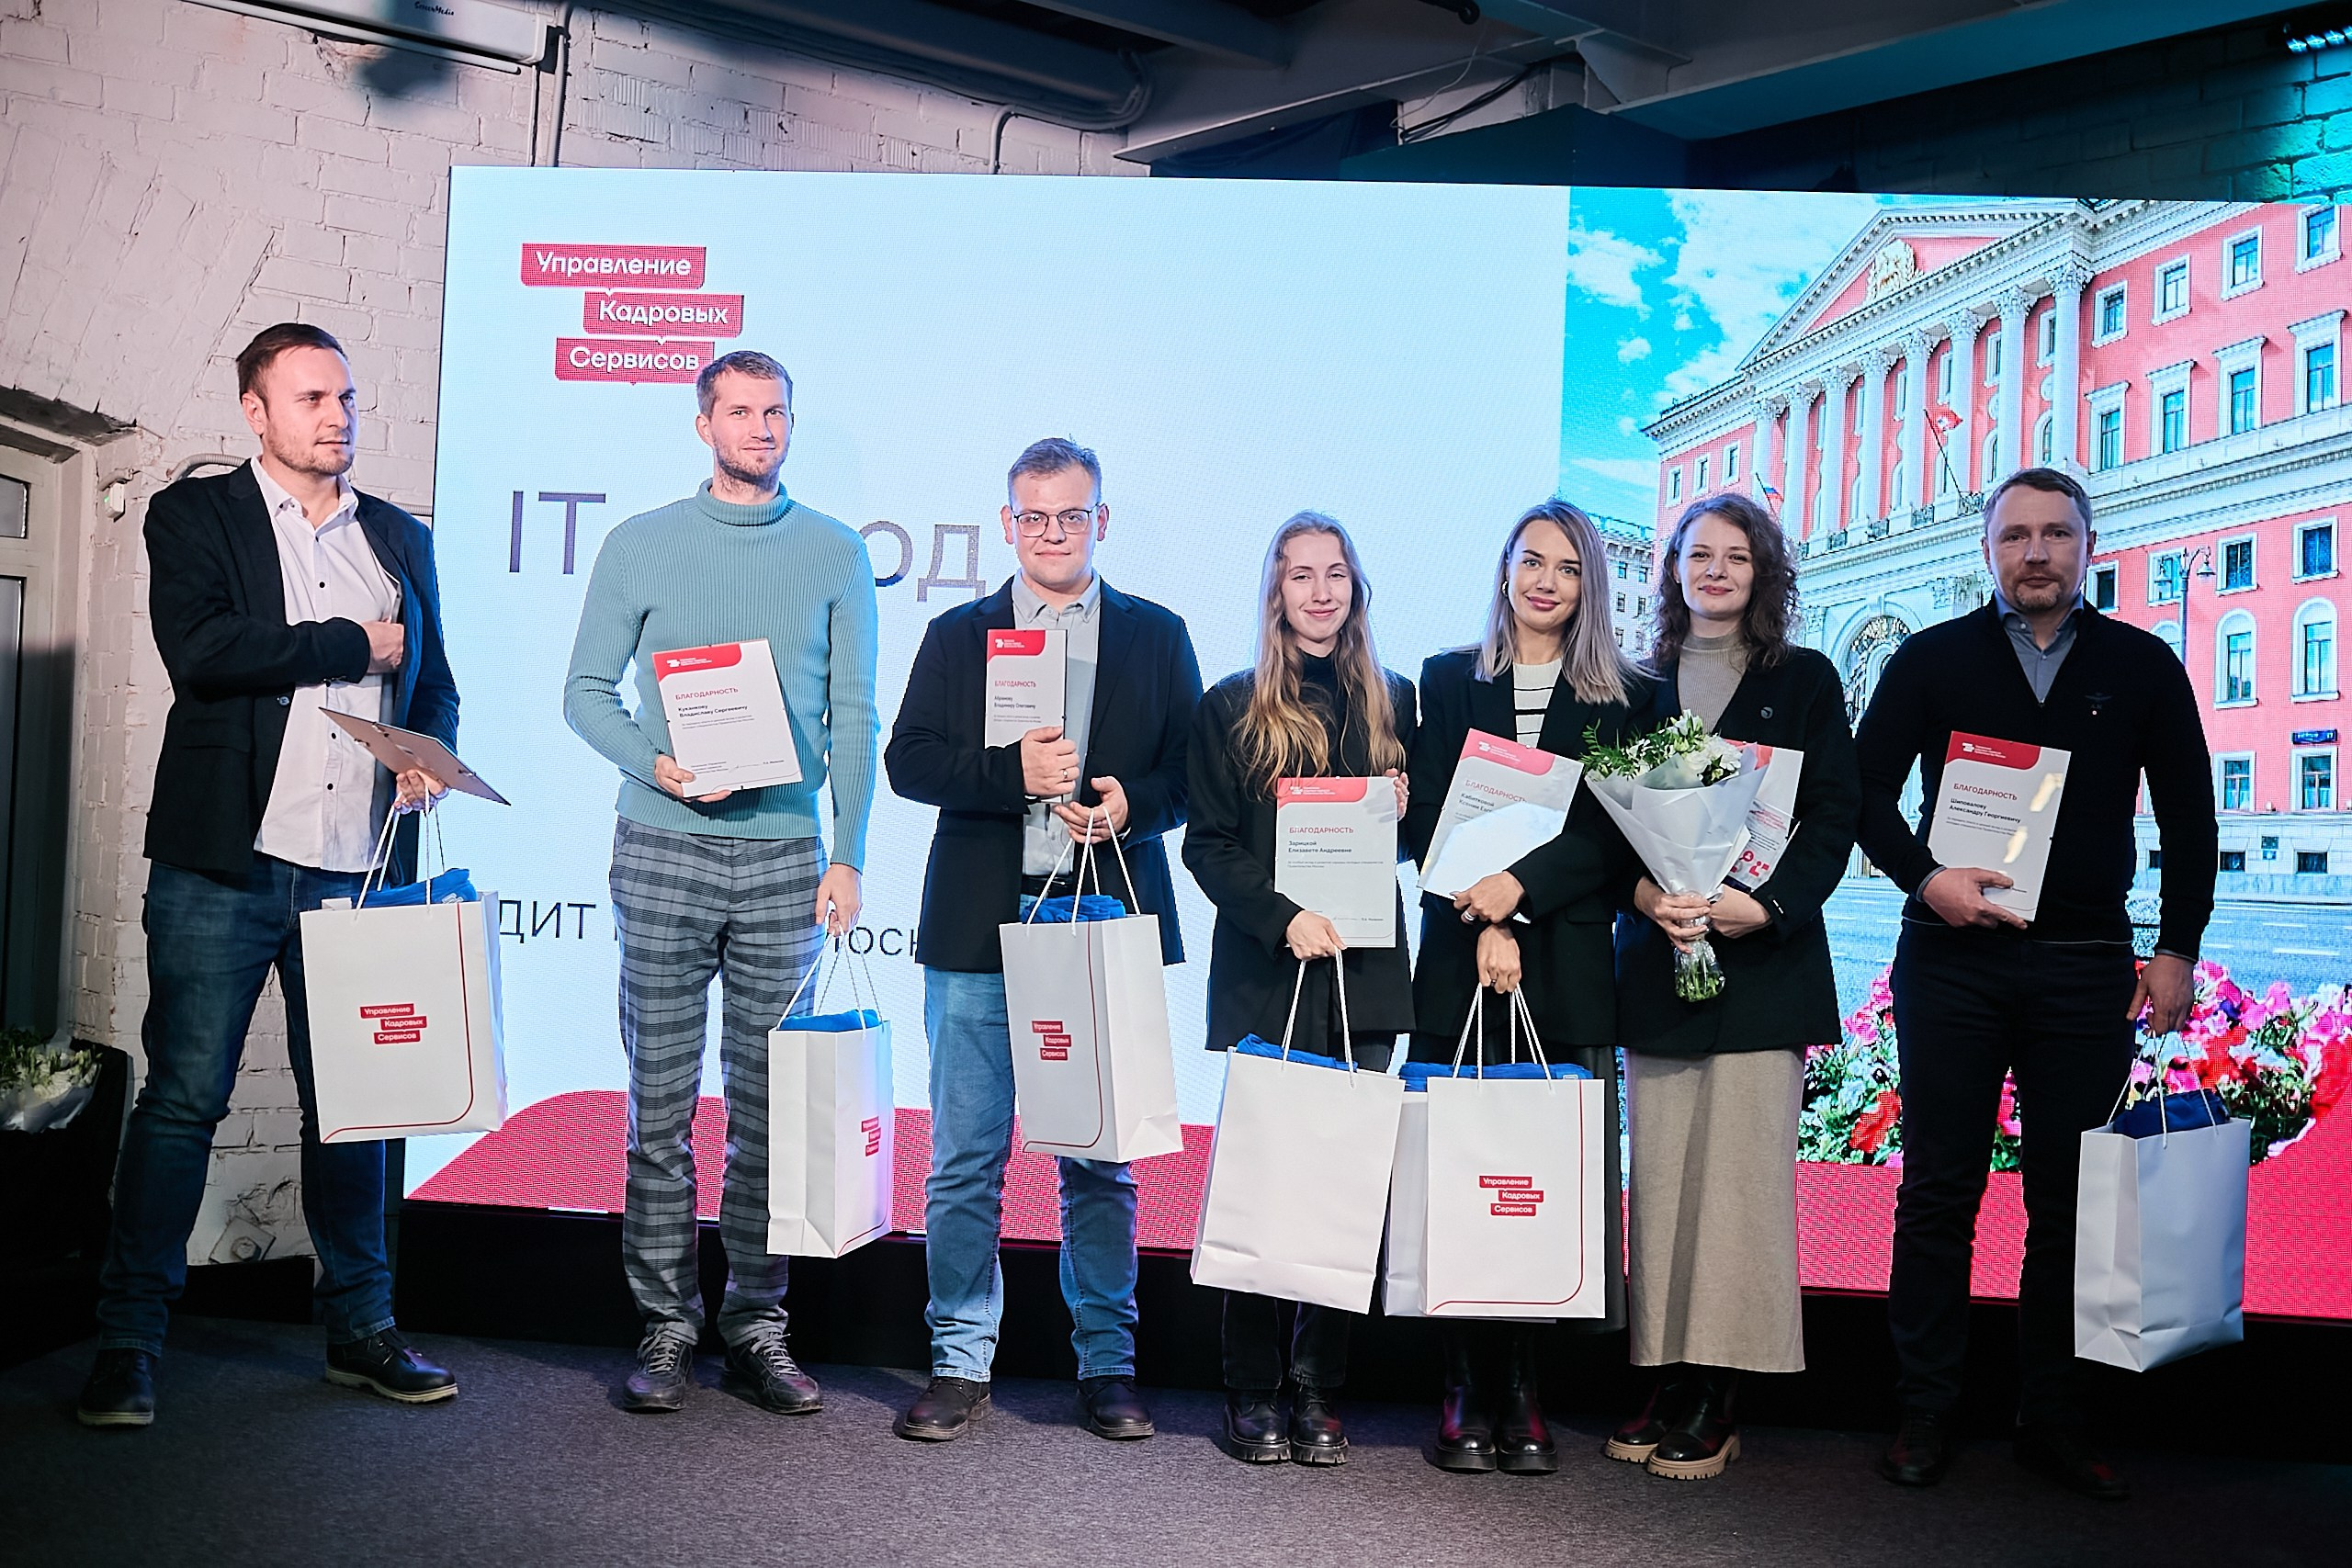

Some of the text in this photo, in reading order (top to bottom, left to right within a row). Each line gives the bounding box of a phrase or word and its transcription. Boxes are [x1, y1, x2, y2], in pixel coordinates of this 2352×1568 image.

[536, 251, 690, 277] Управление
[599, 299, 729, 326] Кадровых
[569, 346, 699, 373] Сервисов
[675, 687, 739, 700] БЛАГОДАРНОСТЬ
[714, 705, 748, 714] Сергеевичу
[1954, 783, 2018, 801] БЛАГОДАРНОСТЬ
[1949, 805, 2021, 824] Александру Георгиевичу
[364, 1007, 411, 1016] Управление
[384, 1019, 424, 1028] Кадровых
[378, 1032, 417, 1042] Сервисов
[1483, 1178, 1529, 1186] Управление
[1502, 1191, 1541, 1201] Кадровых
[1494, 1205, 1532, 1213] Сервисов
